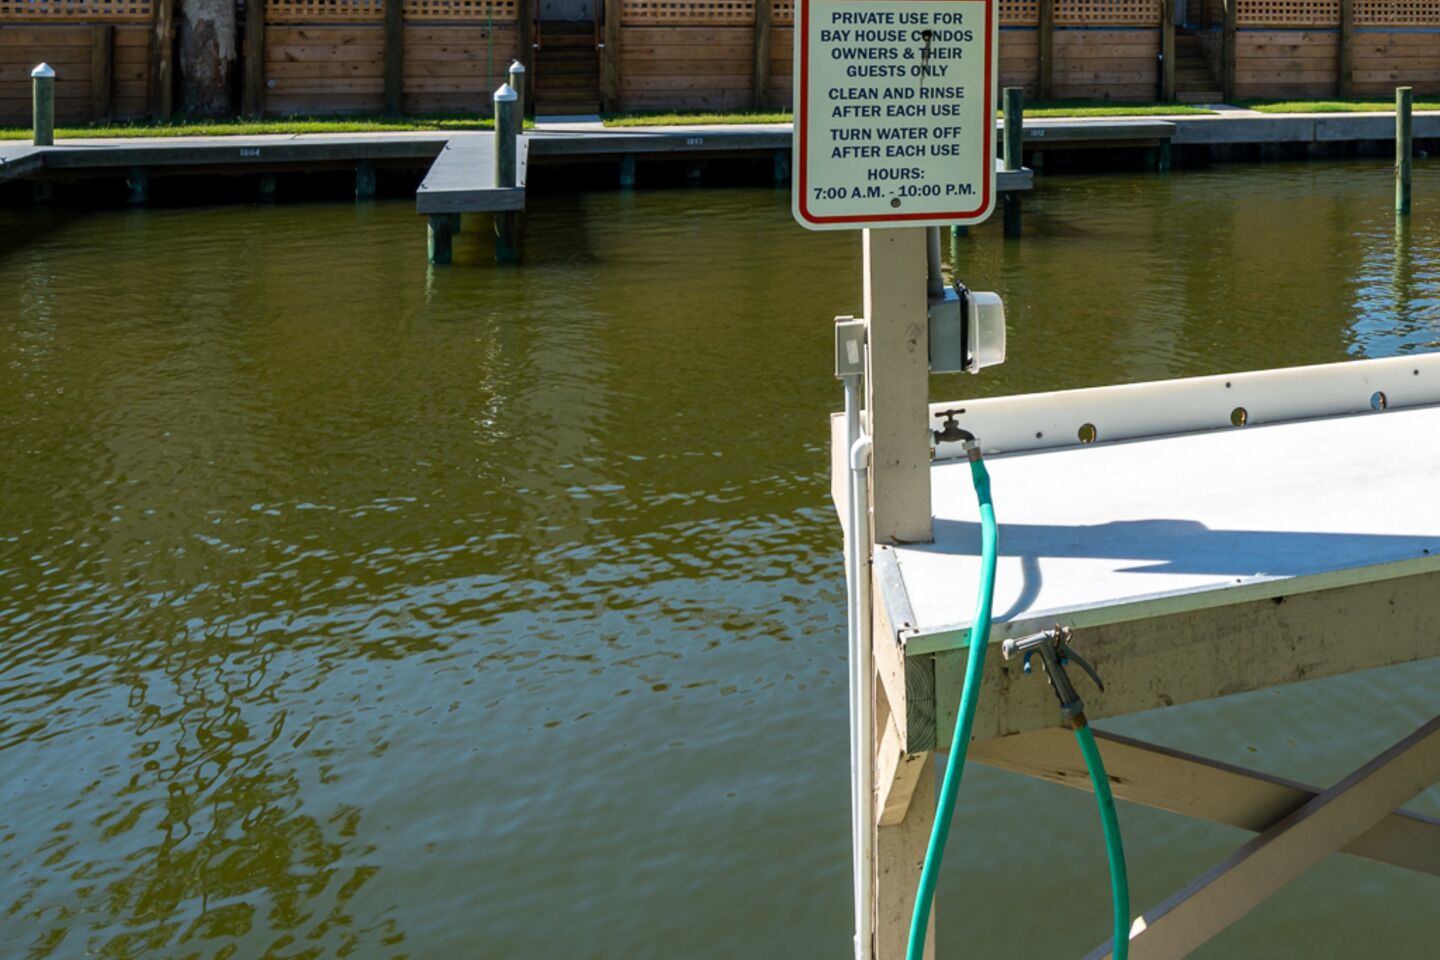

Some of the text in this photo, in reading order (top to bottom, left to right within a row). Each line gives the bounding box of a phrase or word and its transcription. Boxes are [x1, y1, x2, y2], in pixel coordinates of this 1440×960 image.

[832, 12, 963, 25] PRIVATE USE FOR
[820, 30, 851, 42] BAY
[855, 30, 907, 42] HOUSE
[831, 48, 962, 60] OWNERS & THEIR
[846, 65, 948, 77] GUESTS ONLY
[828, 87, 965, 100] CLEAN AND RINSE
[831, 104, 961, 118] AFTER EACH USE
[830, 127, 962, 141] TURN WATER OFF
[831, 144, 960, 158] AFTER EACH USE
[867, 168, 925, 180] HOURS:
[813, 187, 847, 200] 7:00
[851, 186, 885, 199] A.M.
[898, 184, 941, 197] 10:00
[945, 183, 976, 196] P.M.
